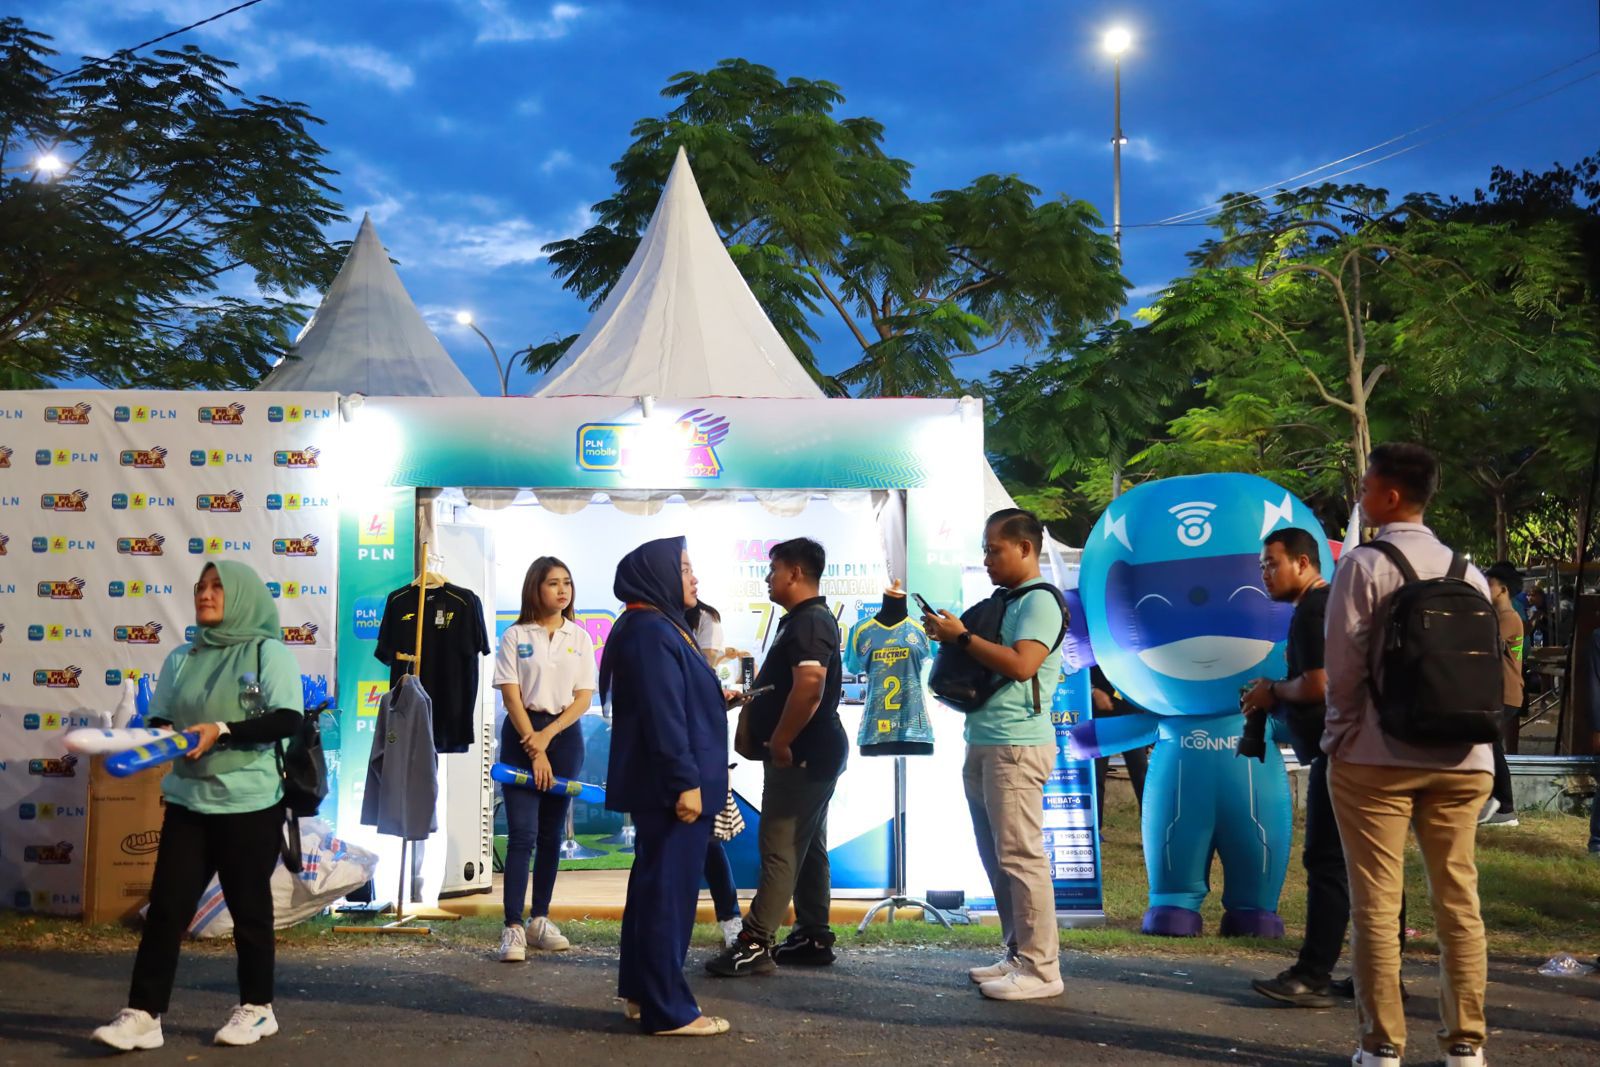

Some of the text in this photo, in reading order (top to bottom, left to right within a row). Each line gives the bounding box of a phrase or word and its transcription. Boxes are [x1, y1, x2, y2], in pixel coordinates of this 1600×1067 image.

[150, 409, 177, 419] PLN
[304, 409, 330, 419] PLN
[72, 453, 98, 462] PLN
[226, 453, 252, 463] PLN
[148, 497, 175, 506] PLN
[302, 497, 328, 506] PLN
[68, 540, 95, 550] PLN
[224, 541, 251, 550] PLN
[358, 548, 395, 560] PLN
[845, 564, 867, 577] PLN
[145, 584, 172, 594] PLN
[301, 586, 327, 595] PLN
[356, 609, 376, 618] PLN
[356, 618, 382, 628] mob
[65, 629, 92, 638] PLN
[874, 650, 907, 660] ELECTRIC
[883, 675, 901, 710] 2
[61, 717, 89, 727] PLN
[1051, 711, 1080, 725] BAT
[356, 720, 375, 732] PL
[1180, 732, 1239, 750] ICONNE
[57, 807, 84, 816] PLN
